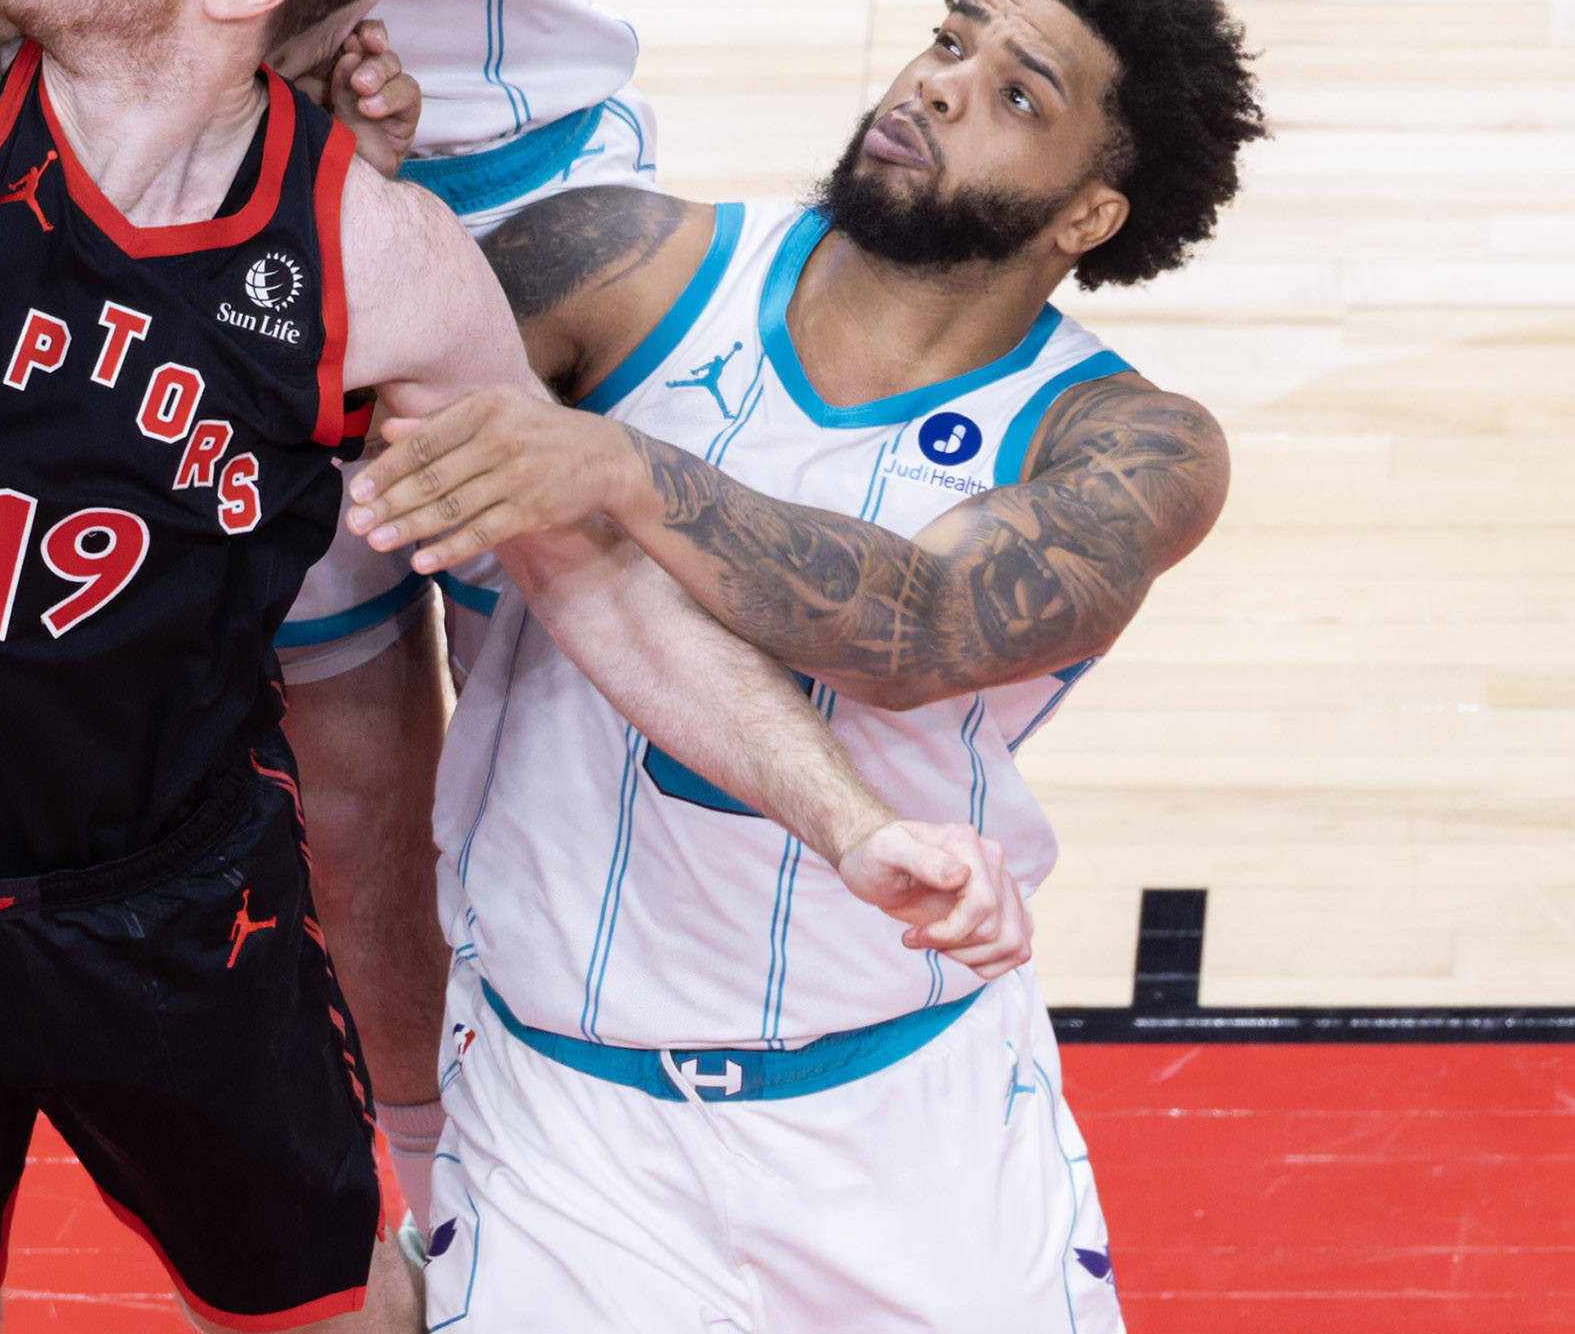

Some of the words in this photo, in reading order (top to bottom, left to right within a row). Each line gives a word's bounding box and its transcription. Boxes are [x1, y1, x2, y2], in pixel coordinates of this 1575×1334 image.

[216, 302, 257, 331] Sun
[259, 314, 301, 344] Life
[883, 457, 930, 482] Judi
